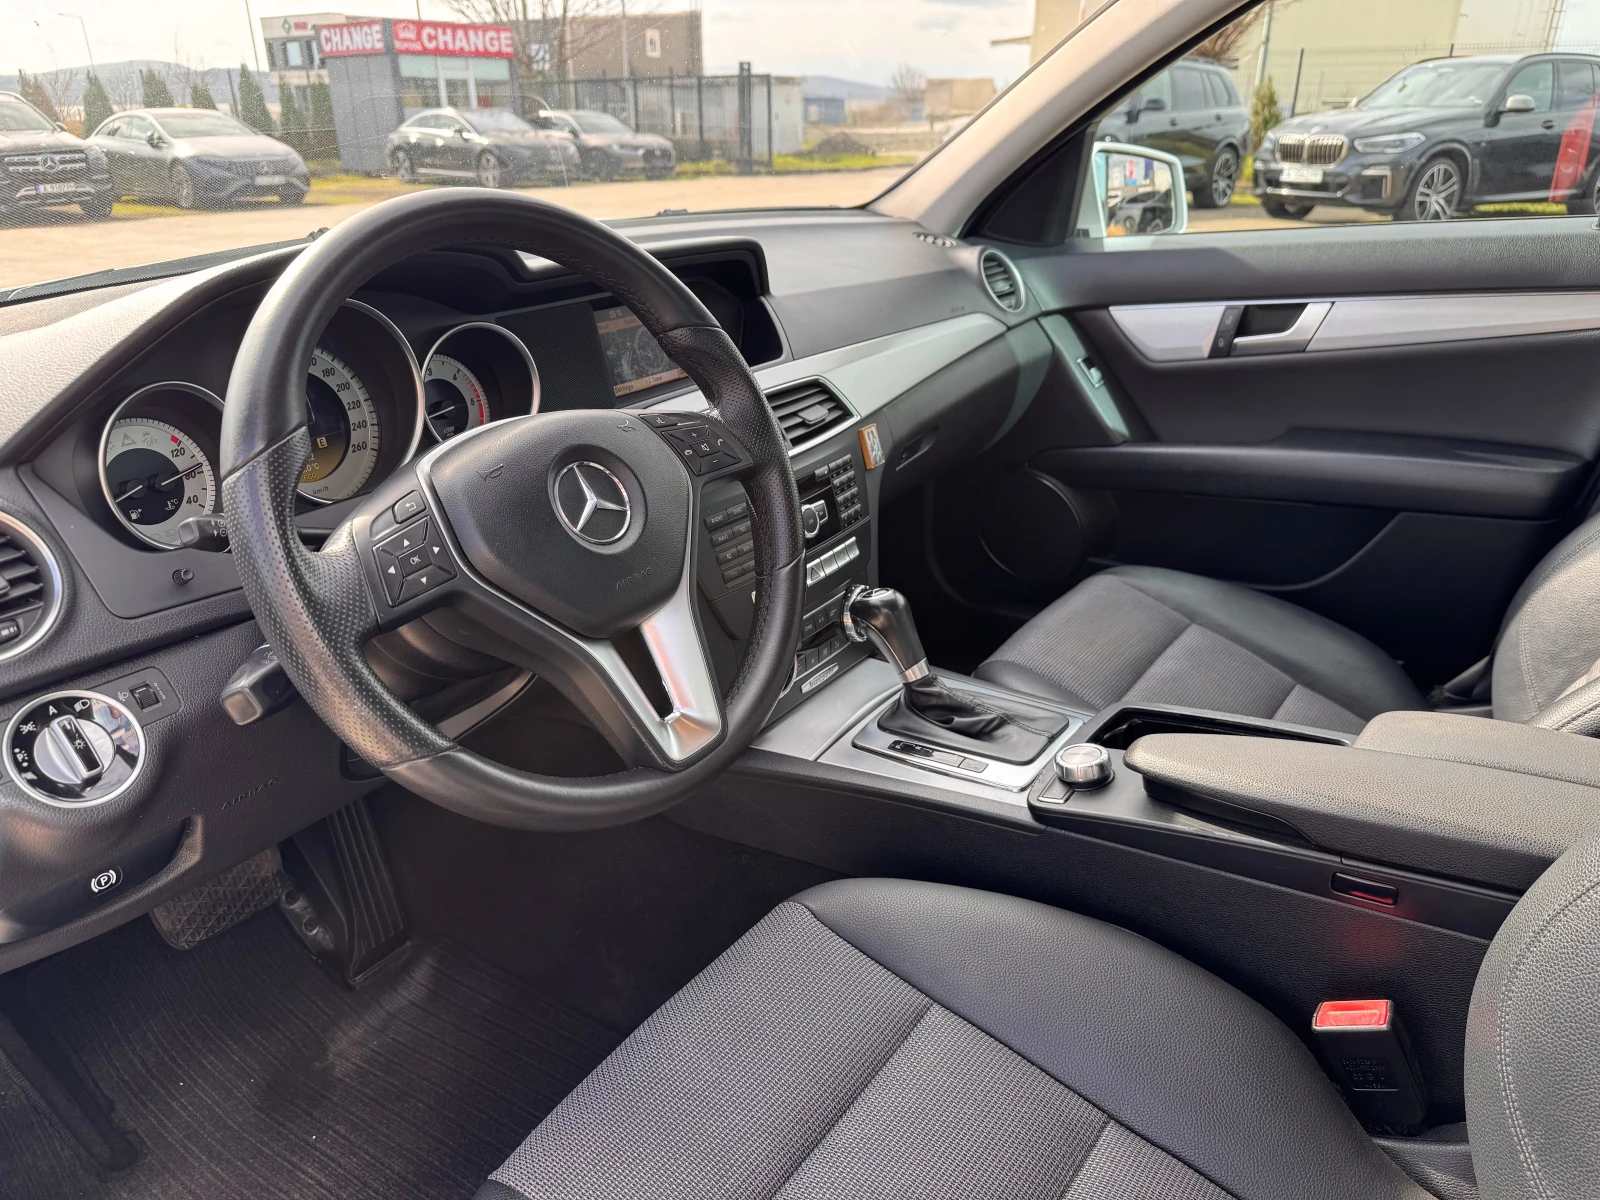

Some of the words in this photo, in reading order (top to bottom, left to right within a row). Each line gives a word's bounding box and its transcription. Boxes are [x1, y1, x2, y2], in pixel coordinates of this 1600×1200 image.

[320, 24, 384, 52] CHANGE
[421, 25, 513, 54] CHANGE
[321, 367, 335, 378] 180
[427, 367, 433, 376] 3
[452, 373, 458, 381] 4
[336, 382, 350, 393] 200
[347, 399, 361, 411] 220
[470, 398, 475, 406] 5
[351, 419, 367, 431] 240
[171, 447, 186, 459] 120
[351, 441, 367, 454] 260
[185, 470, 196, 480] 80
[186, 495, 198, 505] 40
[410, 554, 421, 565] OK
[49, 705, 58, 716] A
